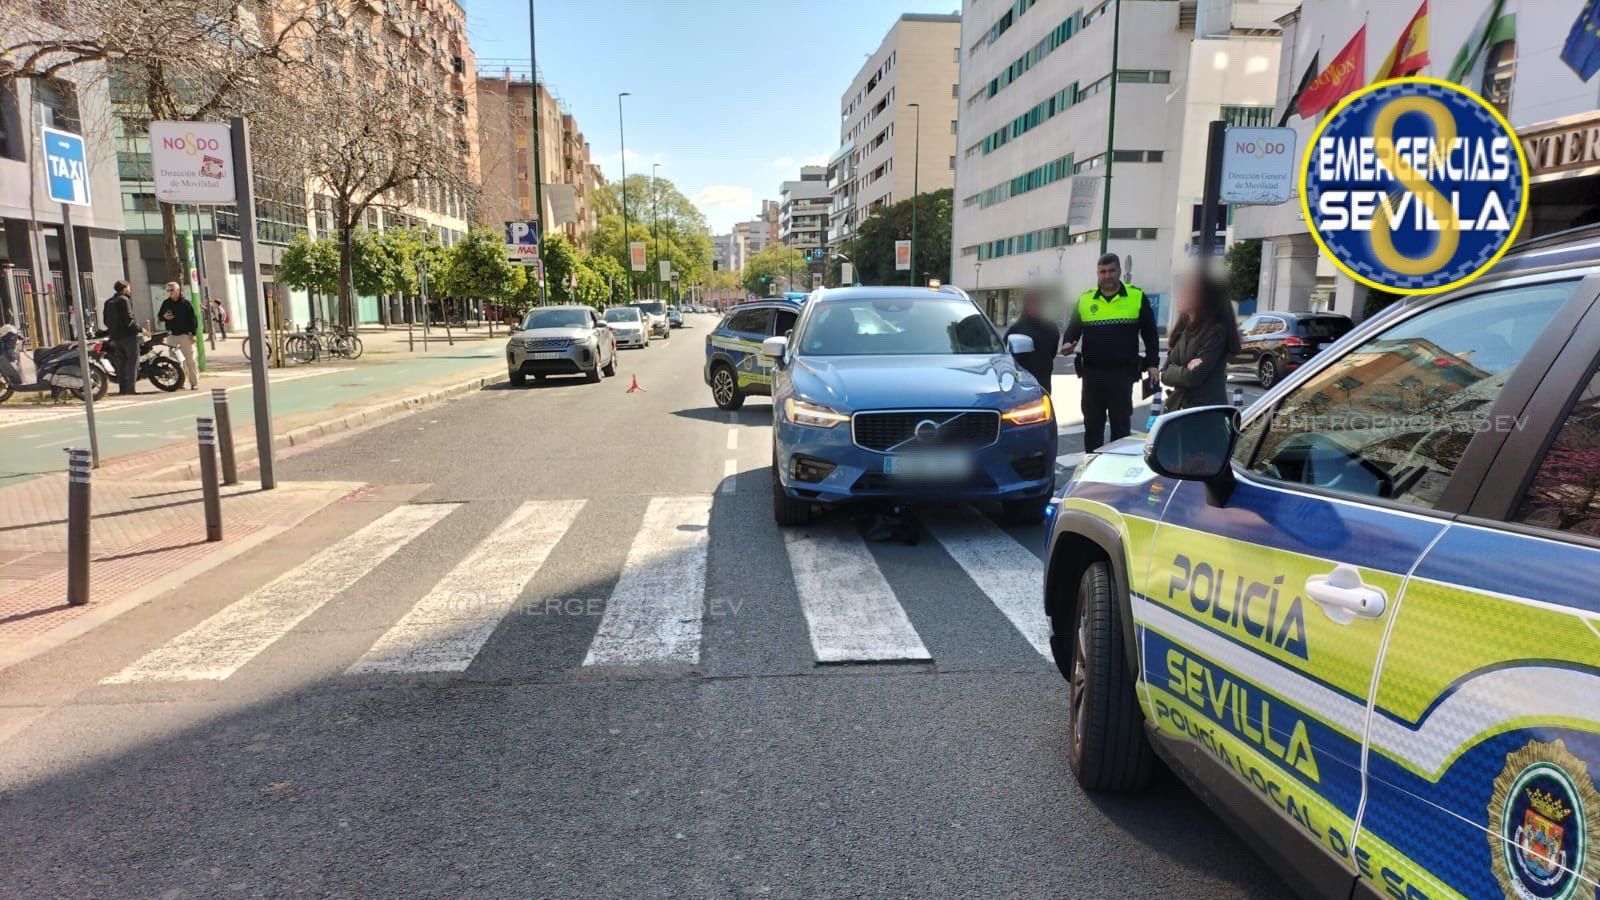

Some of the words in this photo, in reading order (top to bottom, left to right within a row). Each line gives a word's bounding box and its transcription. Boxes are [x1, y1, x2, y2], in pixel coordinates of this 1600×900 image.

[48, 154, 84, 181] TAXI
[512, 222, 530, 244] P
[1168, 553, 1309, 661] POLICÍA
[1166, 648, 1321, 785] SEVILLA
[1236, 755, 1322, 839] LOCAL
[1327, 827, 1375, 881] DE
